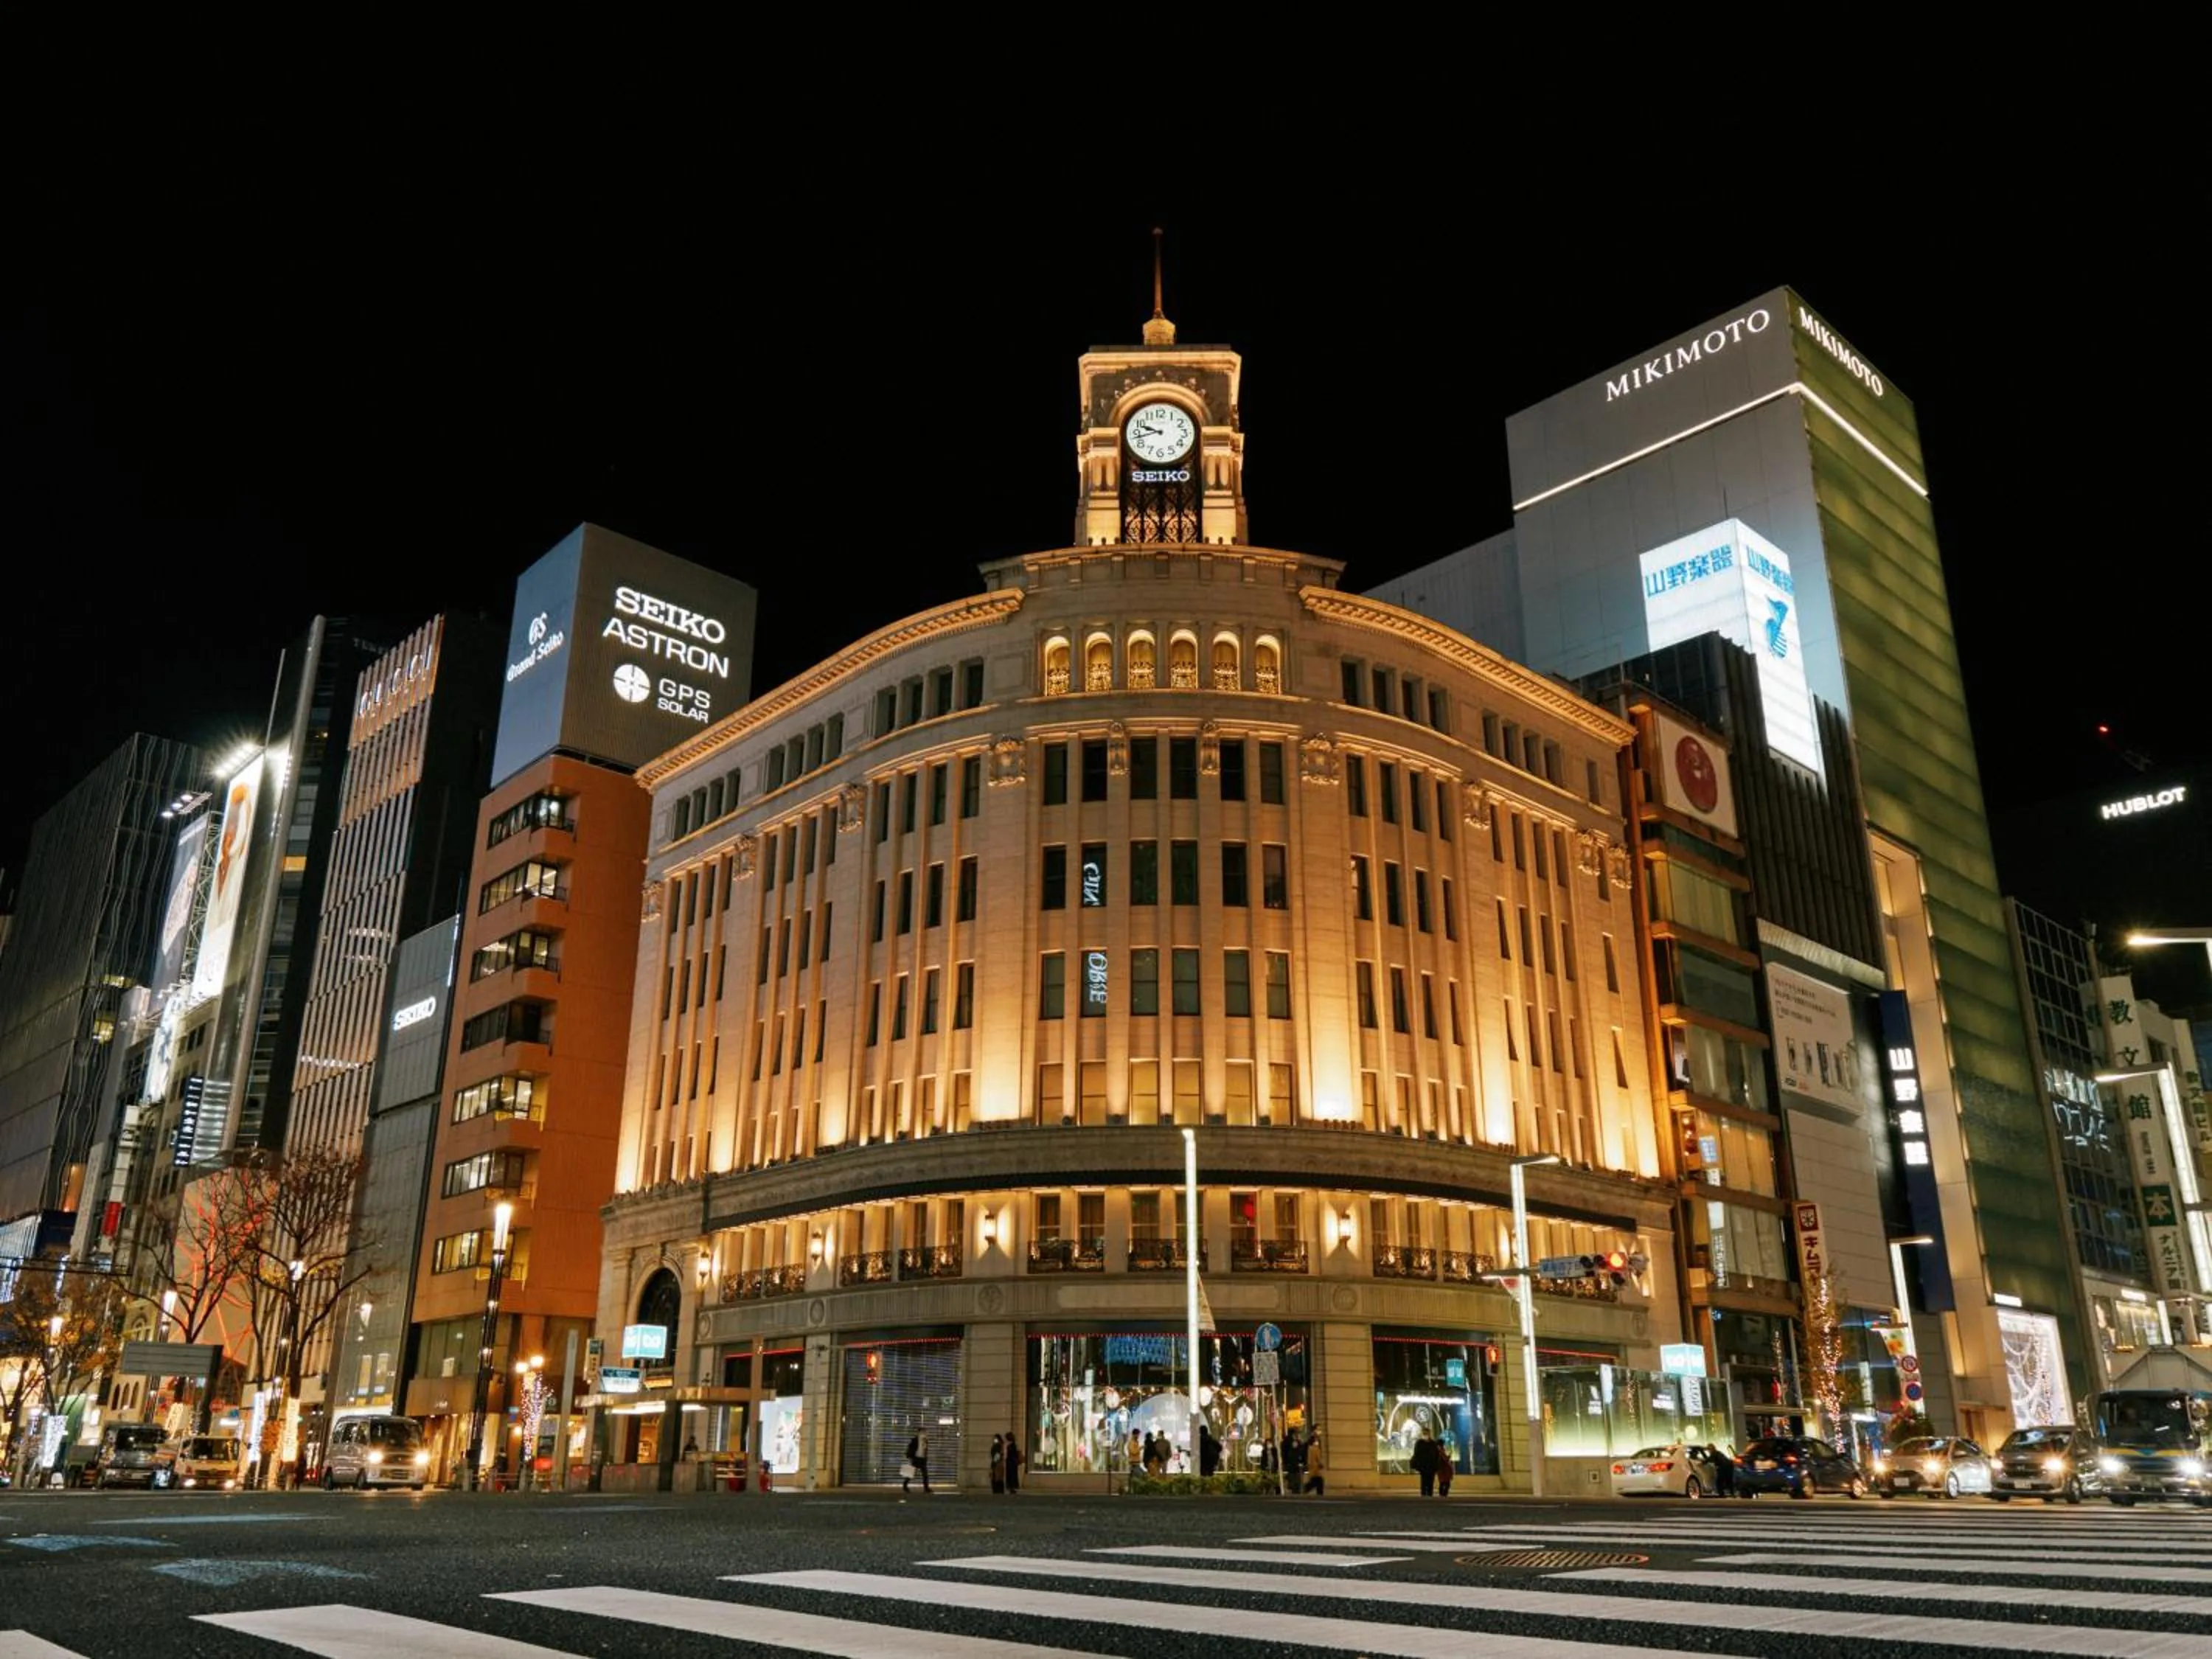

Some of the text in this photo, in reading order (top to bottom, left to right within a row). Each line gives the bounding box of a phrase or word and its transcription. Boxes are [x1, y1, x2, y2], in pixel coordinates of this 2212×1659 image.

[1606, 308, 1770, 402] MIKIMOTO
[1799, 306, 1884, 397] MIKIMOTO
[1145, 411, 1154, 420] 11
[1155, 408, 1166, 418] 12
[1177, 418, 1184, 428] 2
[1180, 428, 1188, 438] 3
[1136, 439, 1145, 448] 8
[1167, 445, 1175, 455] 5
[1155, 448, 1164, 458] 6
[1132, 470, 1190, 482] SEIKO
[1645, 543, 1733, 598] 山野楽器
[614, 585, 726, 644] SEIKO
[602, 617, 729, 679] ASTRON
[658, 677, 711, 709] GPS
[658, 699, 709, 724] SOLAR
[2101, 786, 2186, 819] HUBLOT
